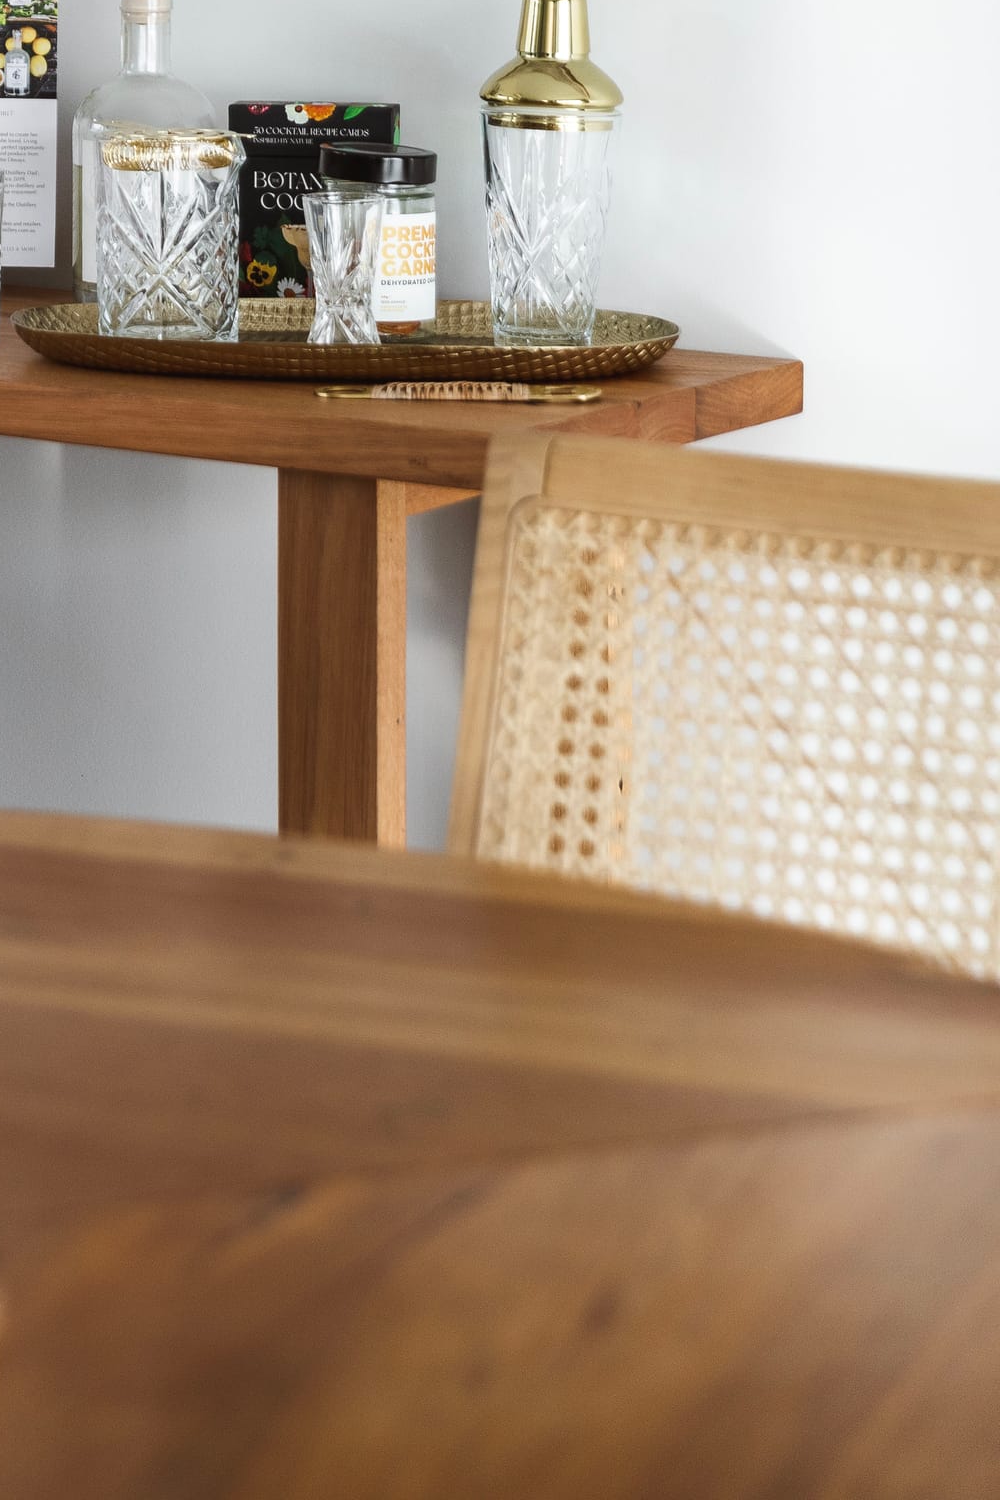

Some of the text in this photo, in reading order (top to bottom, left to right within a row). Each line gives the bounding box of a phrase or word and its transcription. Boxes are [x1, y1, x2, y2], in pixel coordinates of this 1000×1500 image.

[266, 126, 309, 136] COCKTAIL
[310, 127, 338, 137] RECIPE
[340, 127, 370, 137] CARDS
[380, 278, 426, 286] DEHYDRATED
